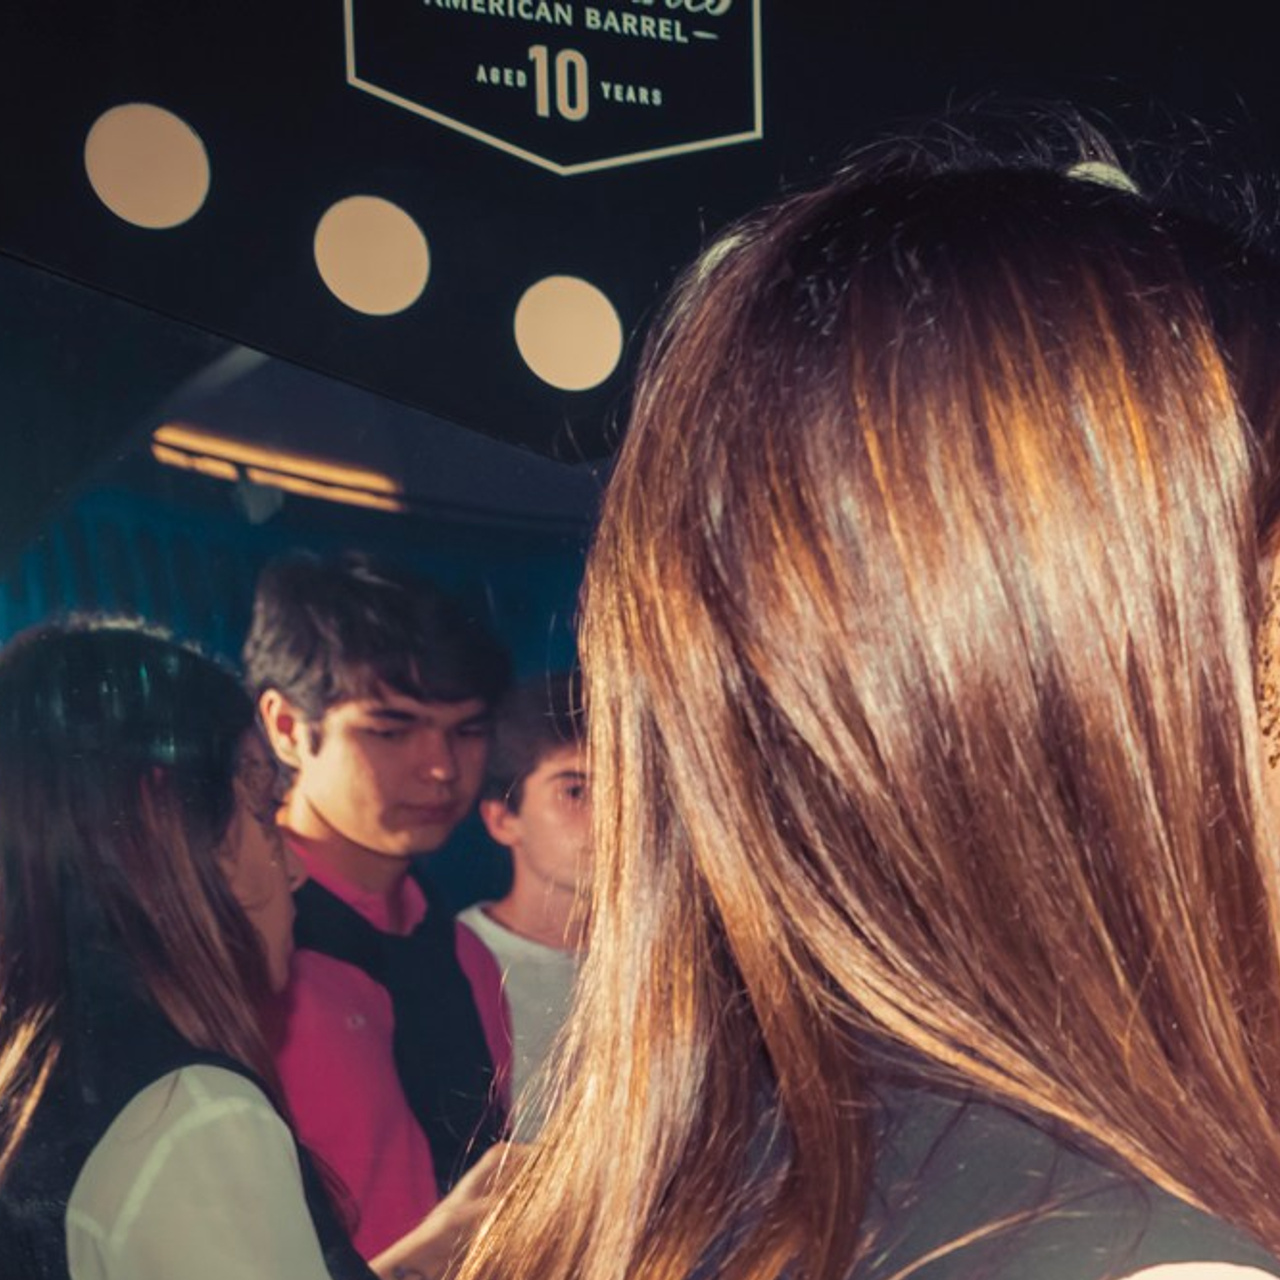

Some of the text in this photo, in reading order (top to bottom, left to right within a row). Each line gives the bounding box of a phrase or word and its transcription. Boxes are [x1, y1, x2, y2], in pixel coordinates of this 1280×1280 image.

[585, 7, 689, 43] BARREL
[476, 45, 663, 121] AGED 10 YEARS
